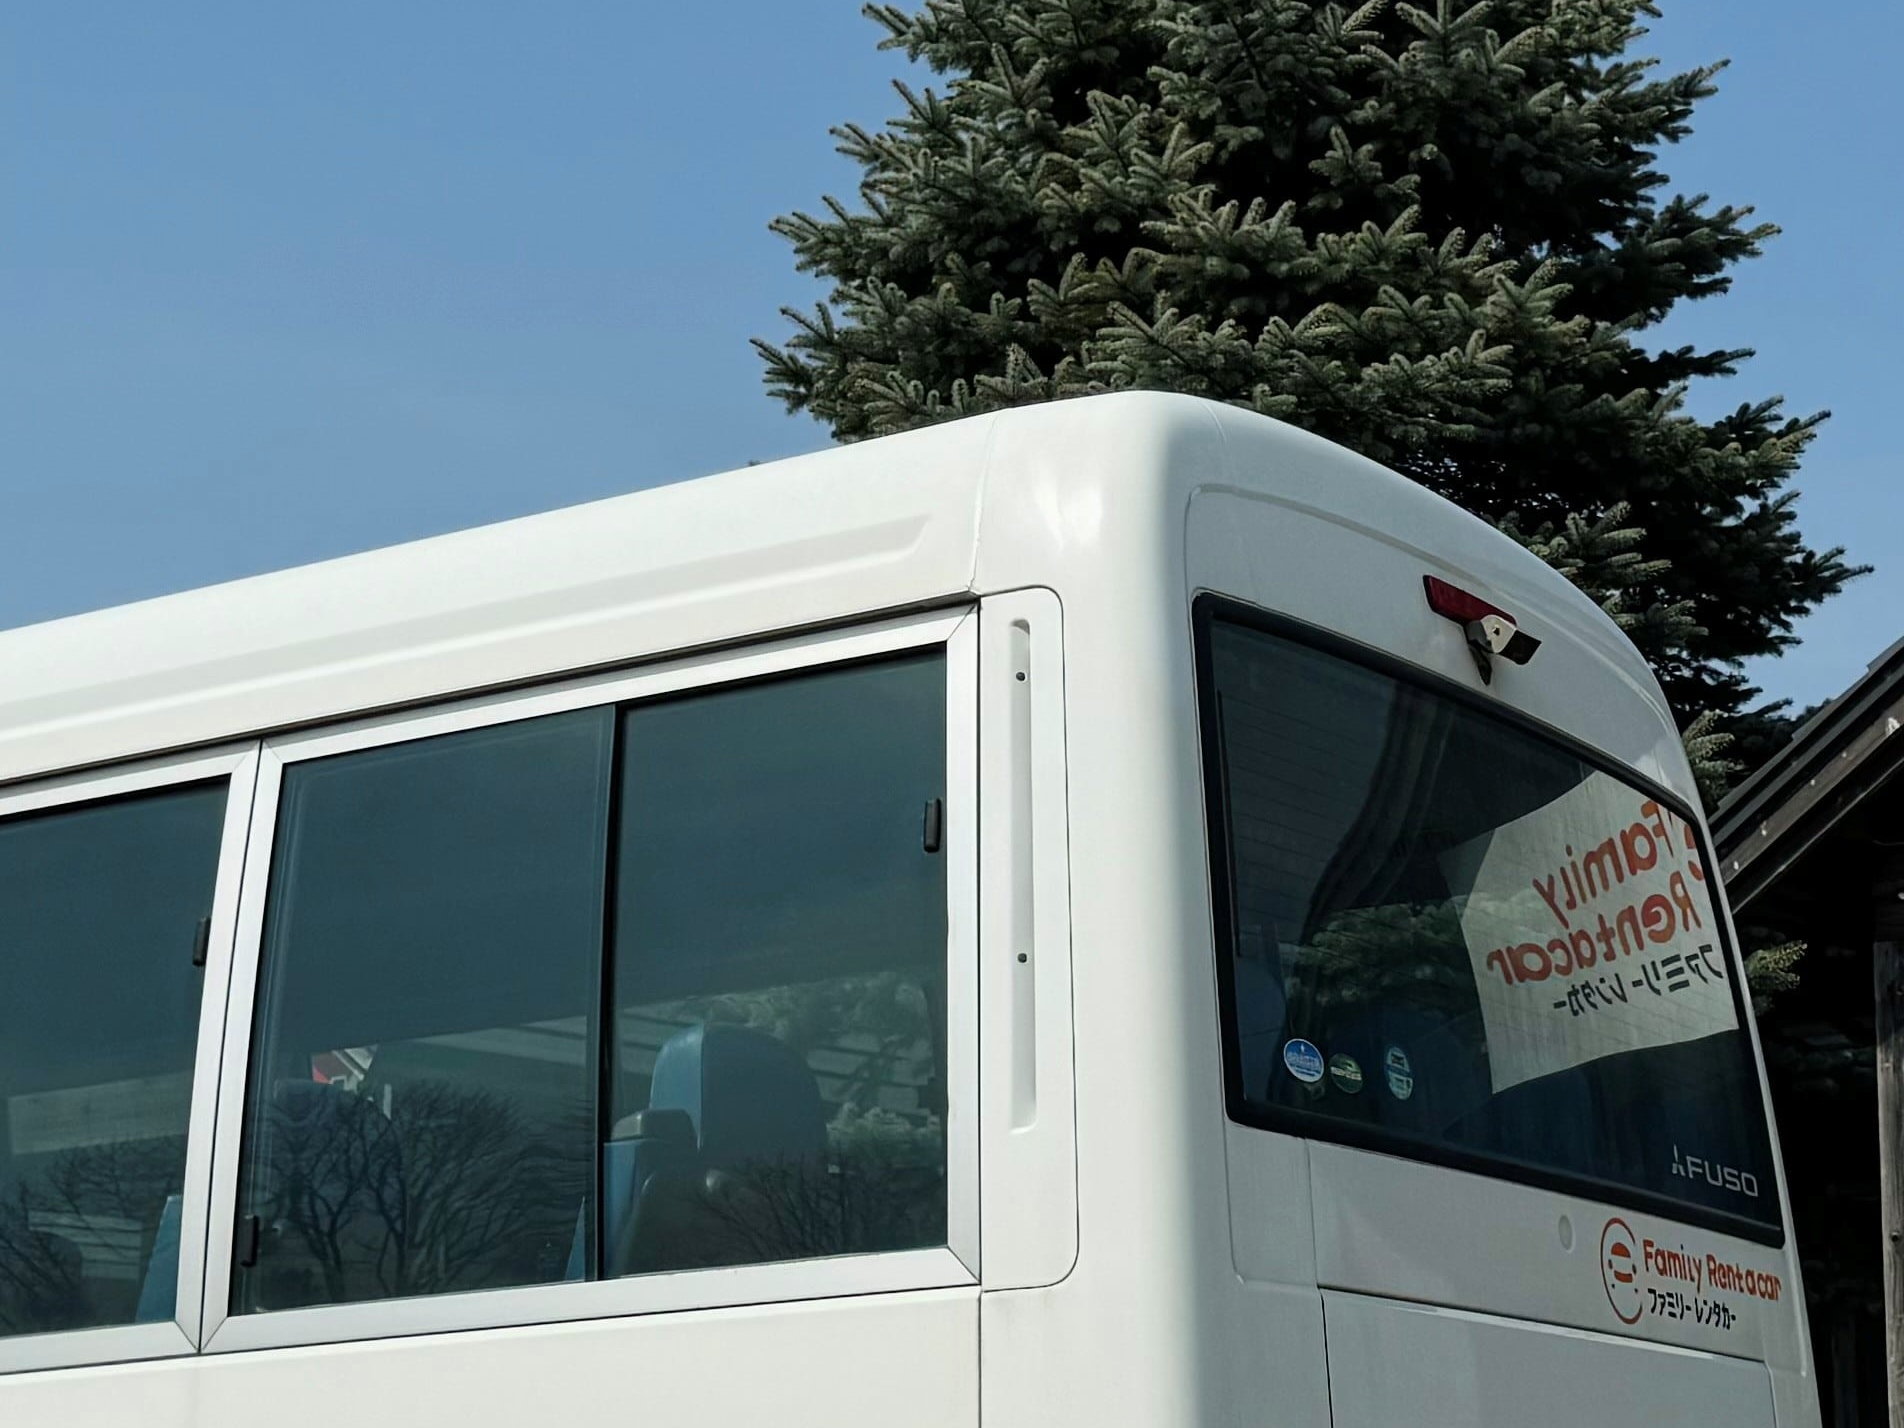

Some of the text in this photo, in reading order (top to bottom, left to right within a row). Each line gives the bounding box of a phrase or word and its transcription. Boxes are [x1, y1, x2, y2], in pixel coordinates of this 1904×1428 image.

[1686, 1155, 1760, 1198] FUSO
[1642, 1238, 1702, 1294] Family
[1647, 1287, 1692, 1321] ファミリー
